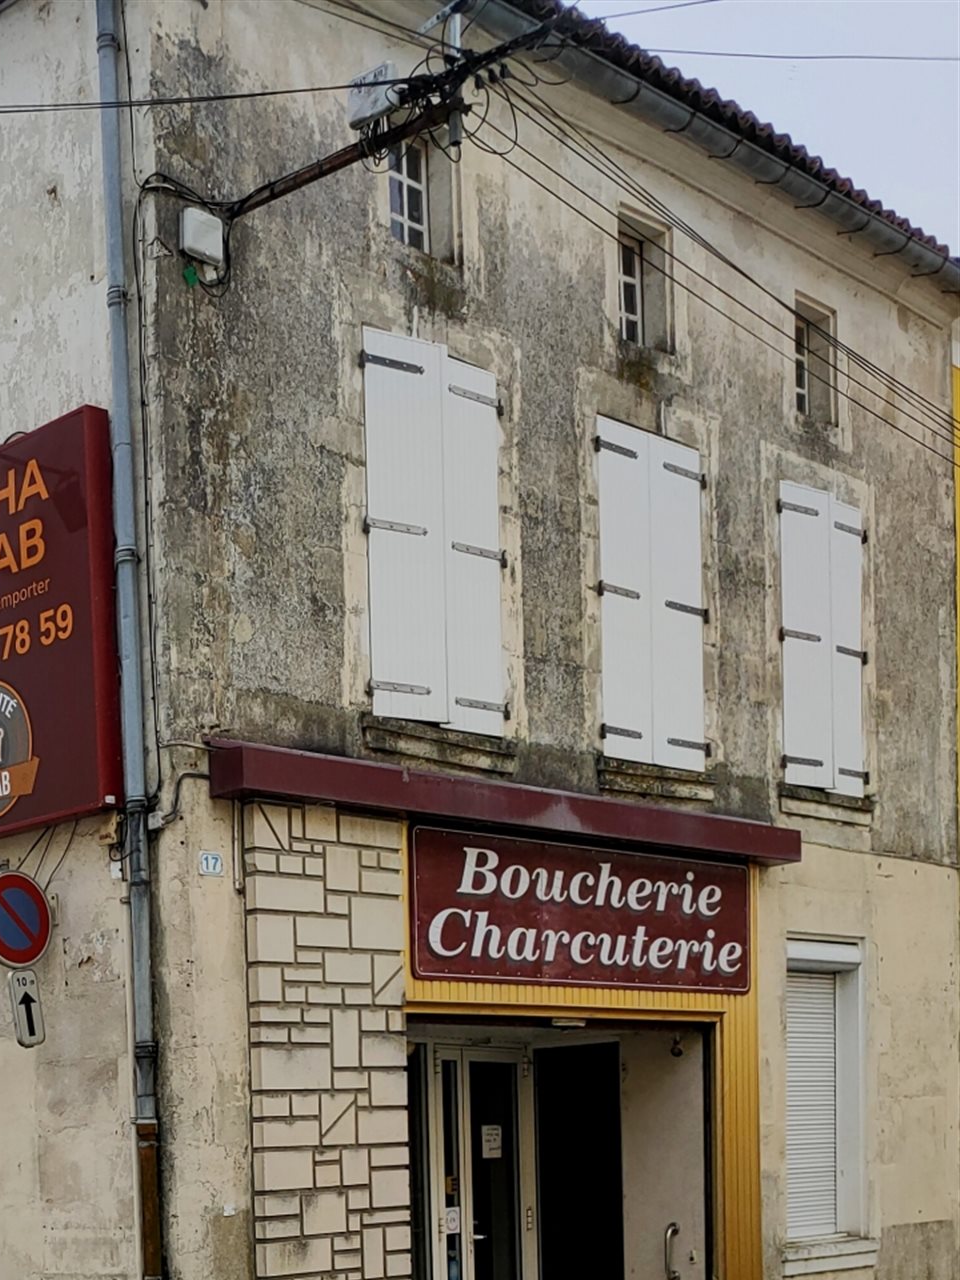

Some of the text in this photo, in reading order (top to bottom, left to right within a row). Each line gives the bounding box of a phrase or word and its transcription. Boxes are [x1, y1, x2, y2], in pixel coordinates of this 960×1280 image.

[40, 603, 74, 646] 59
[203, 855, 219, 871] 17
[456, 846, 722, 917] Boucherie
[428, 907, 742, 973] Charcuterie
[16, 976, 28, 987] 10
